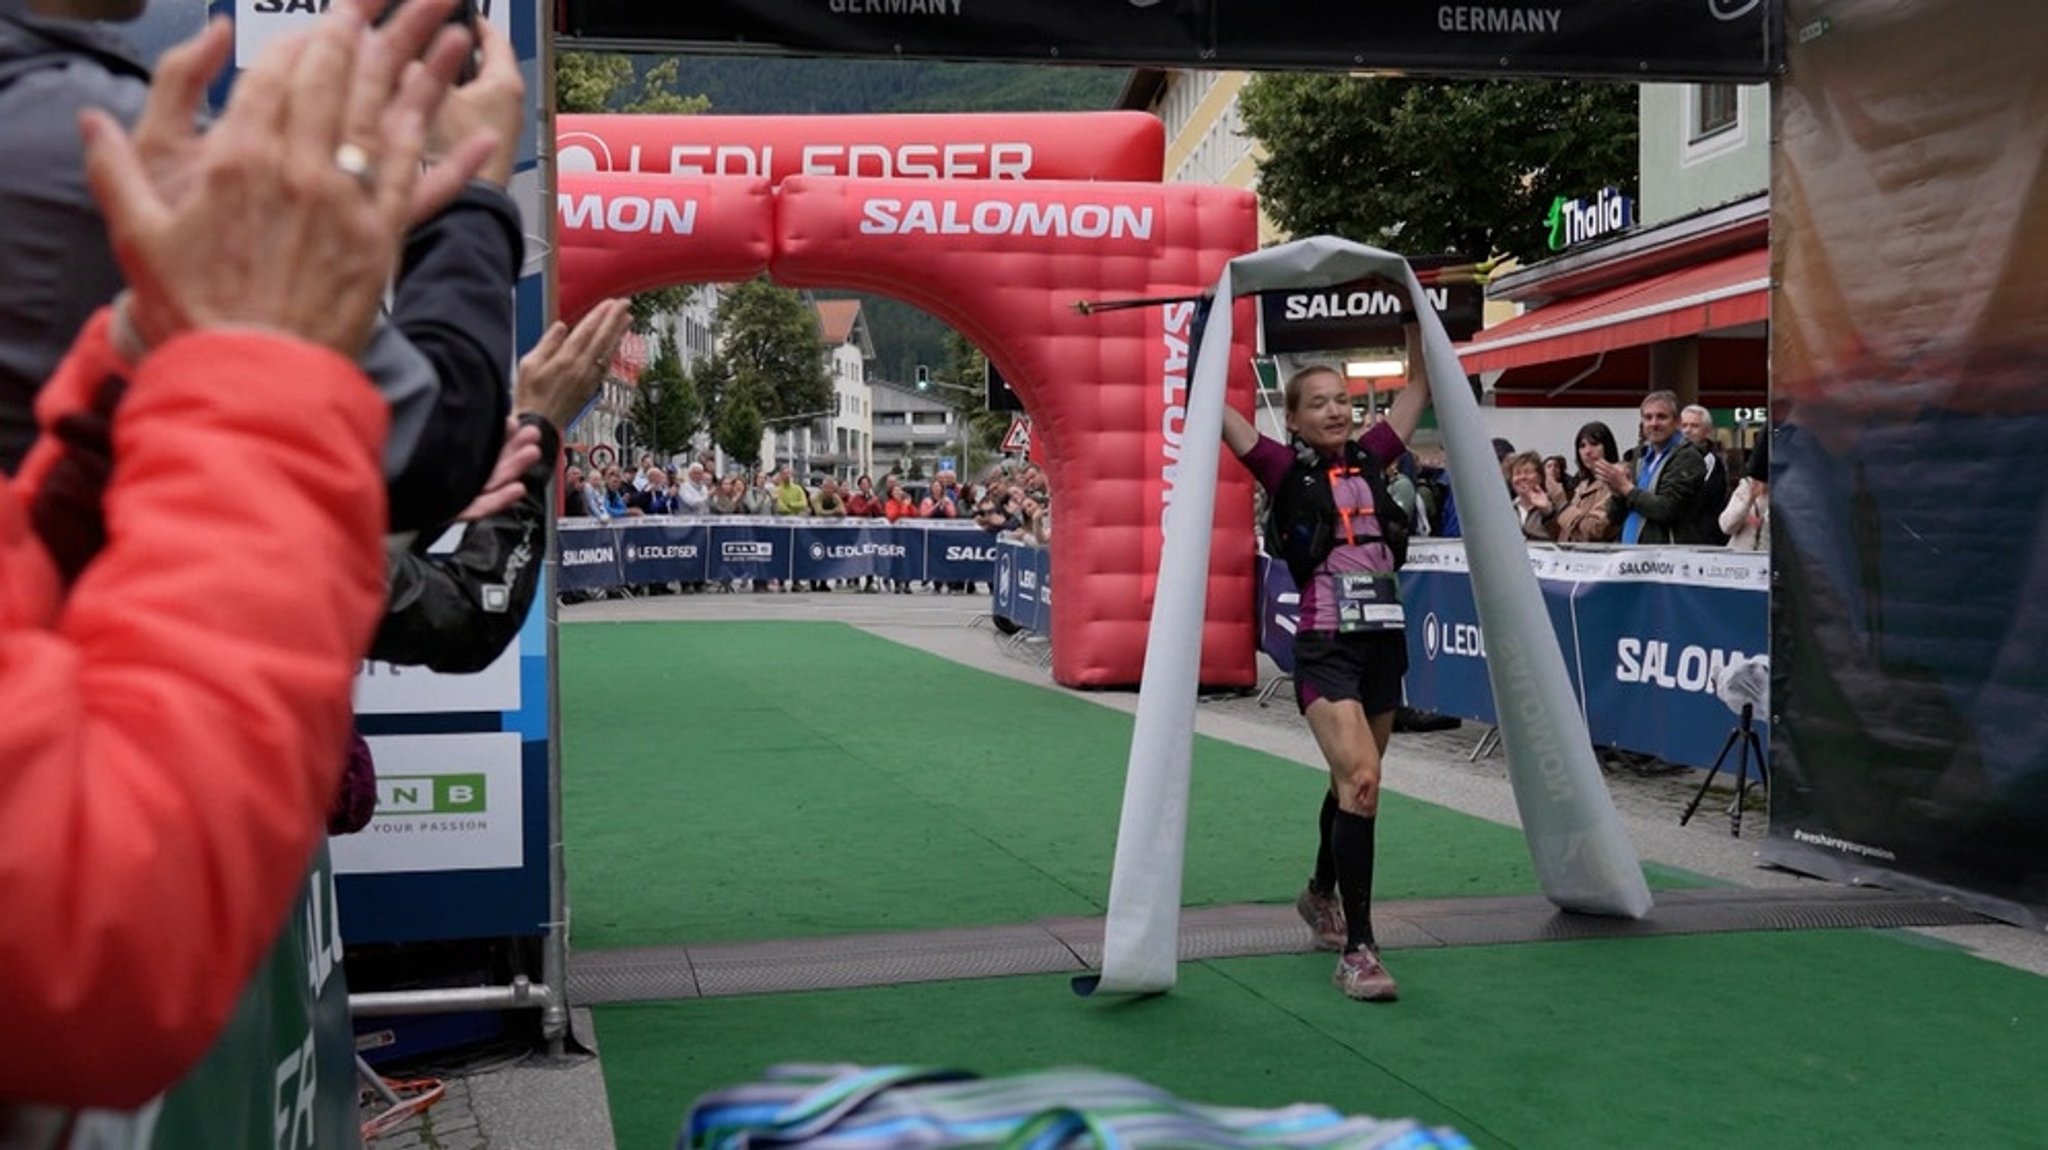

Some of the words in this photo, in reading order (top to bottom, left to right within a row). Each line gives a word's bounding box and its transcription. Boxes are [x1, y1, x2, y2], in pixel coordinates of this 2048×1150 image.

[829, 0, 963, 15] GERMANY
[1437, 5, 1561, 33] GERMANY
[859, 198, 1153, 240] SALOMON
[1561, 186, 1623, 247] Thalia
[1285, 288, 1448, 320] SALOMN
[562, 547, 615, 567] SALOMON
[826, 543, 906, 559] LEDLENSER
[1616, 560, 1676, 576] SALOMON
[372, 822, 414, 834] YOUR
[420, 819, 488, 833] PASSION
